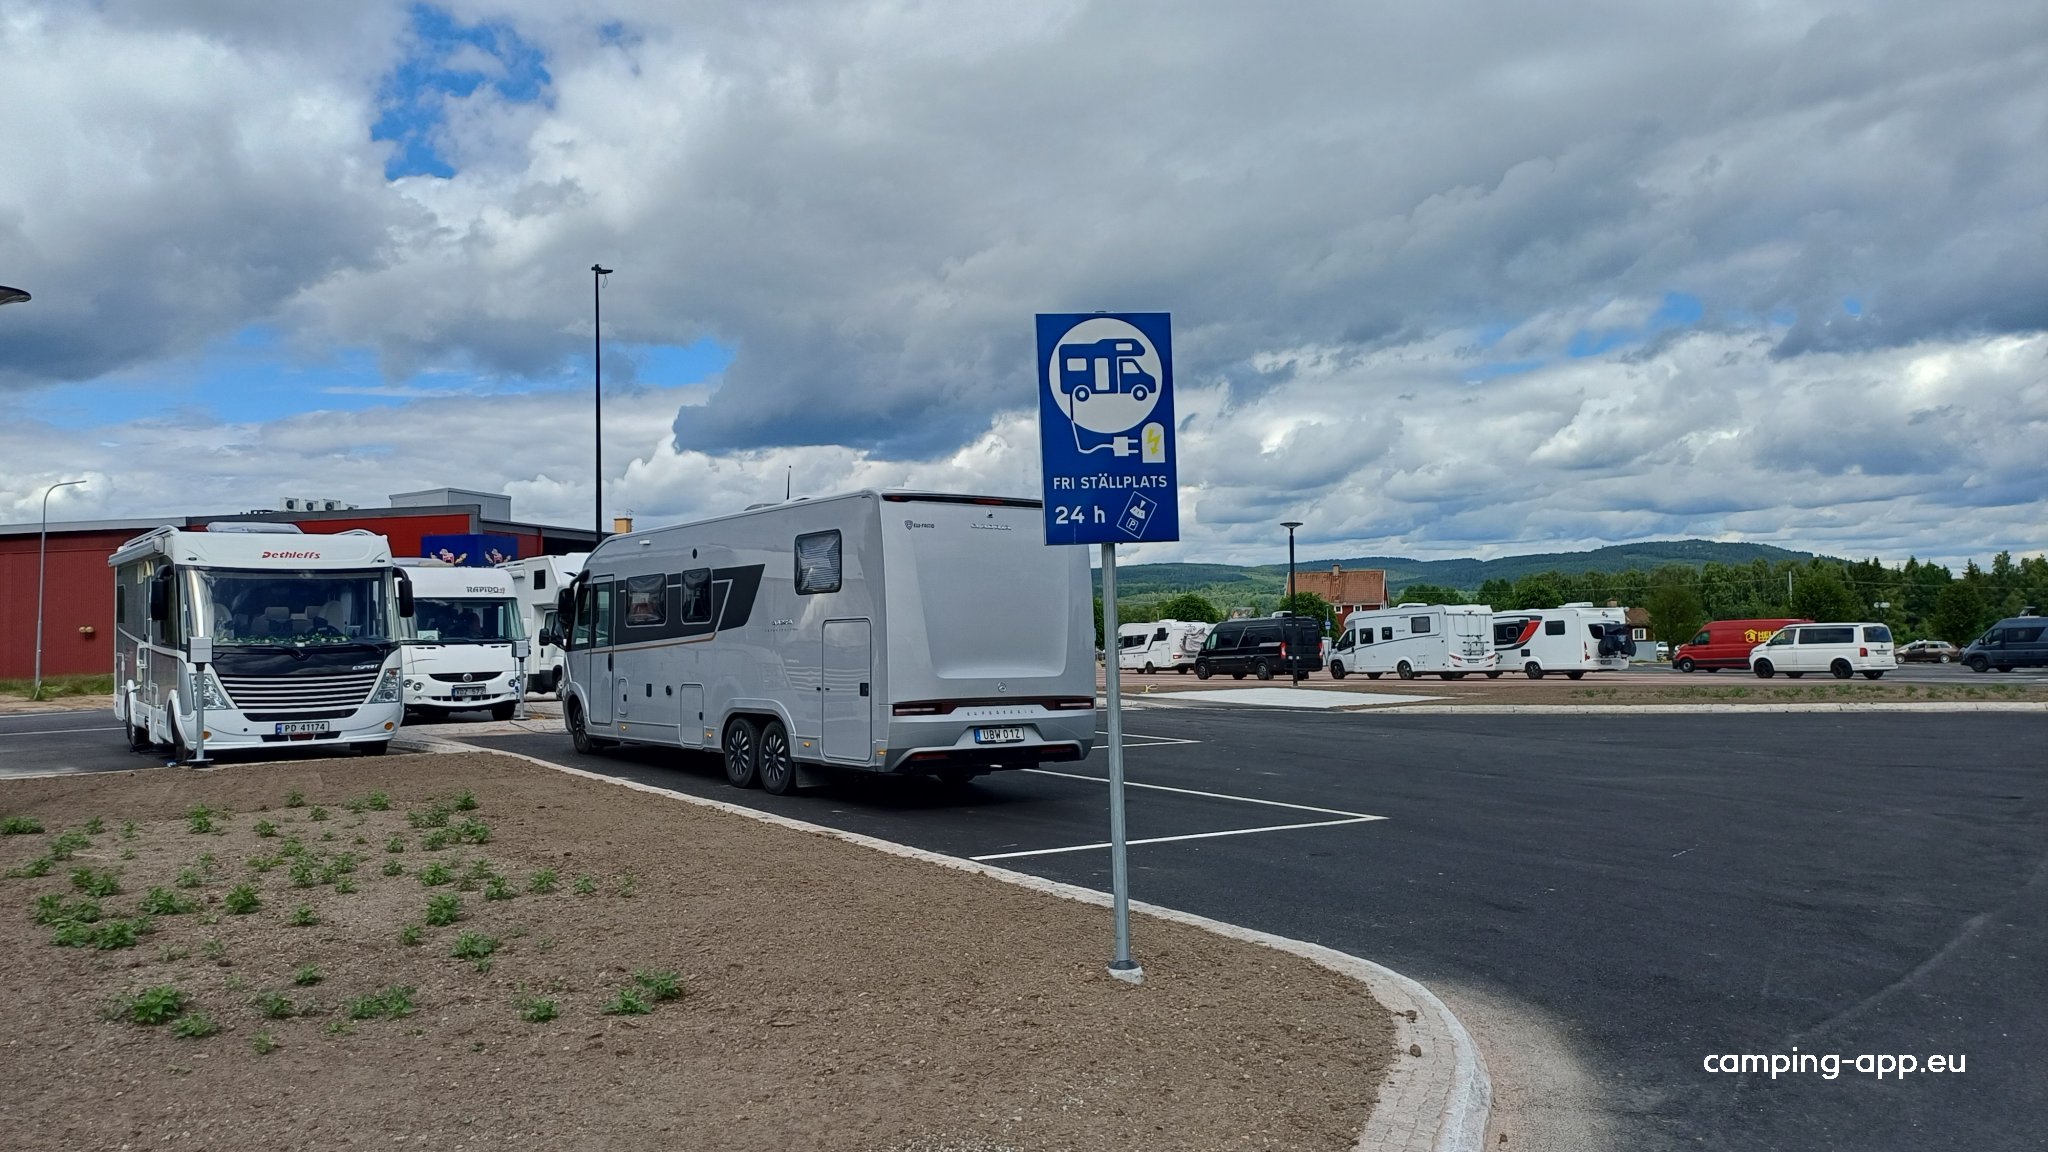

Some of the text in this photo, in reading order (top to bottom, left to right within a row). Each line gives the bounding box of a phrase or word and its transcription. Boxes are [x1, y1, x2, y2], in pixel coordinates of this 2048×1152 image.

[1053, 472, 1168, 490] FRI STÄLLPLATS
[1055, 505, 1085, 525] 24
[1093, 504, 1106, 524] h
[261, 551, 321, 559] Dethleffs
[284, 723, 325, 732] PD 41174
[983, 729, 1001, 740] UBW
